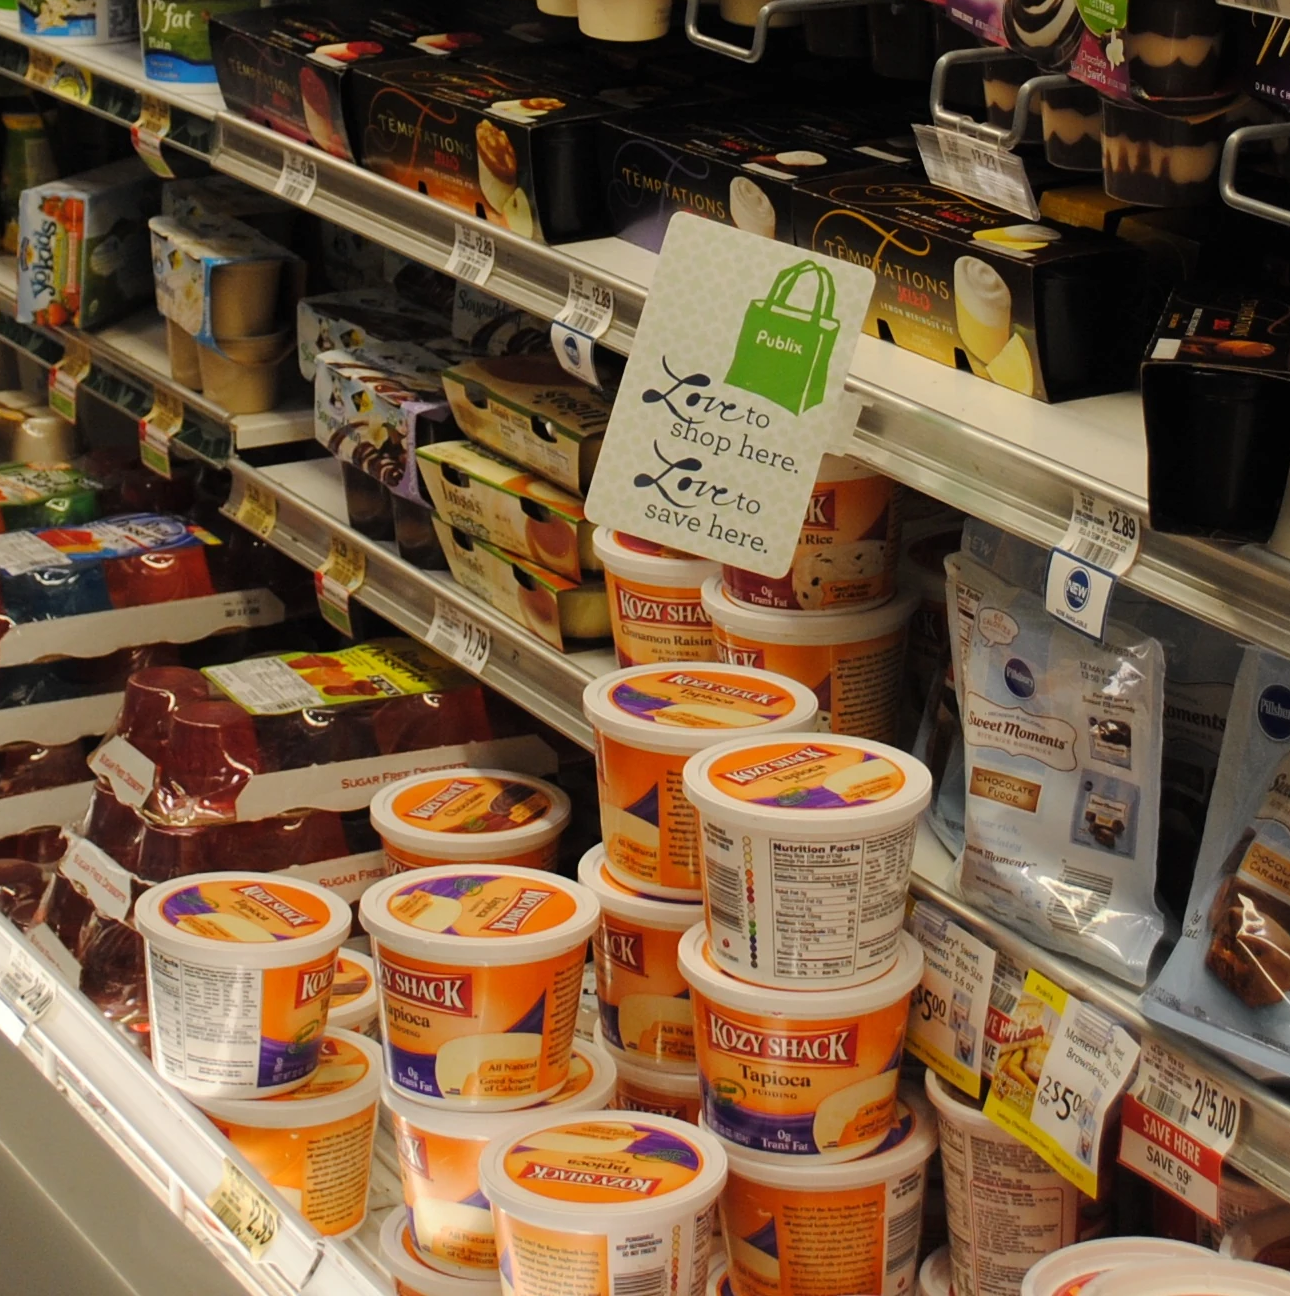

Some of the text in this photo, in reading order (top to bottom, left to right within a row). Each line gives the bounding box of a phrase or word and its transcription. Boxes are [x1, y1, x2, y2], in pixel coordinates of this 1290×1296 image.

[755, 329, 804, 357] Publix
[642, 355, 771, 430] Love to
[670, 417, 800, 475] shop here.
[633, 439, 737, 509] Love
[645, 503, 769, 555] save here.
[1107, 510, 1137, 540] $2.89
[619, 588, 664, 622] KOZY
[463, 621, 487, 661] $1.79
[621, 625, 671, 646] Cinnamon
[1003, 722, 1069, 751] Moments
[341, 773, 380, 789] SUGAR
[975, 772, 1036, 799] CHOCOLATE
[987, 786, 1020, 804] FUDGE
[772, 842, 861, 854] Nutrition Facts
[395, 972, 464, 1010] SHACK
[709, 1013, 851, 1061] KOZY SHACK
[488, 1060, 538, 1072] All Natural
[738, 1063, 812, 1089] Tapioca
[398, 1073, 433, 1093] Trans Fat
[752, 1088, 798, 1101] PUDDING
[1191, 1078, 1237, 1140] 2/$5.00
[761, 1136, 809, 1152] Trans Fat
[1143, 1113, 1202, 1167] SAVE HERE
[1146, 1146, 1174, 1176] SAVE
